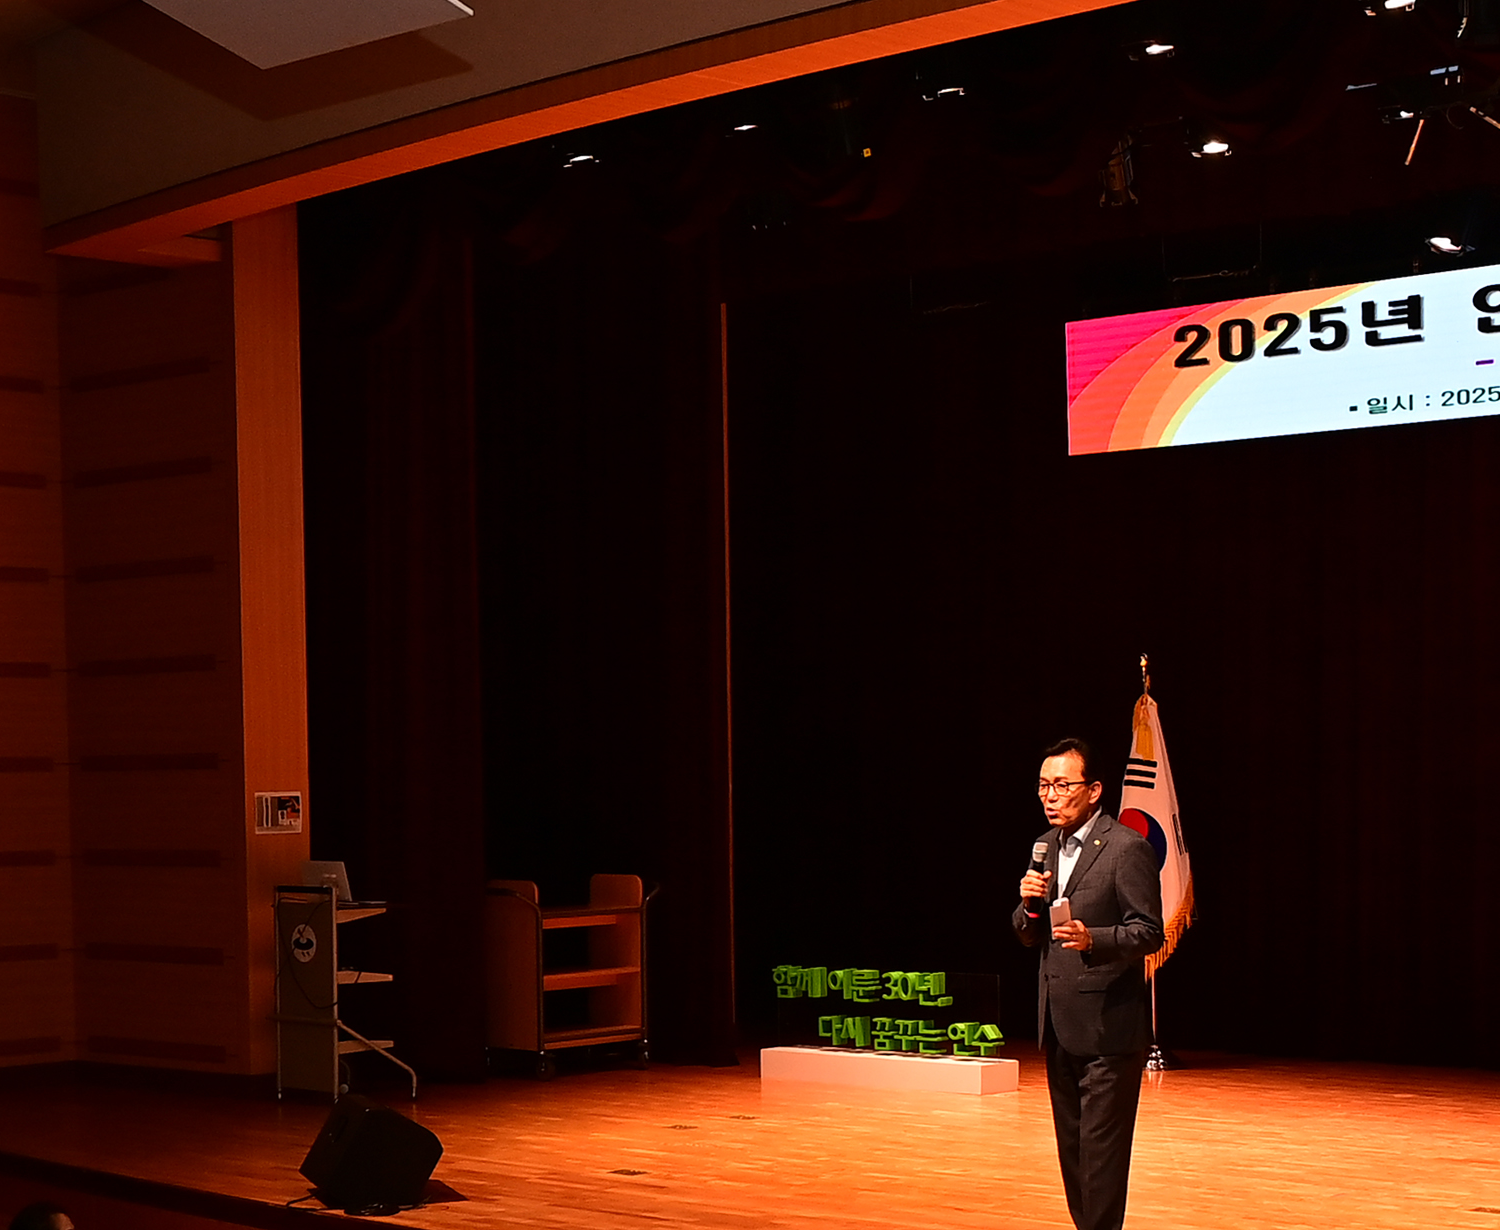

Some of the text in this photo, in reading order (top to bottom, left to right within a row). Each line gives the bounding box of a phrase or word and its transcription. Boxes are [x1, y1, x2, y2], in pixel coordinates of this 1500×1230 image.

[1174, 294, 1424, 368] 2025년
[1366, 394, 1414, 415] 일시
[772, 964, 828, 999] 함께
[827, 967, 883, 1003] 이룬
[818, 1014, 1006, 1057] 다시 꿈꾸는 연수
